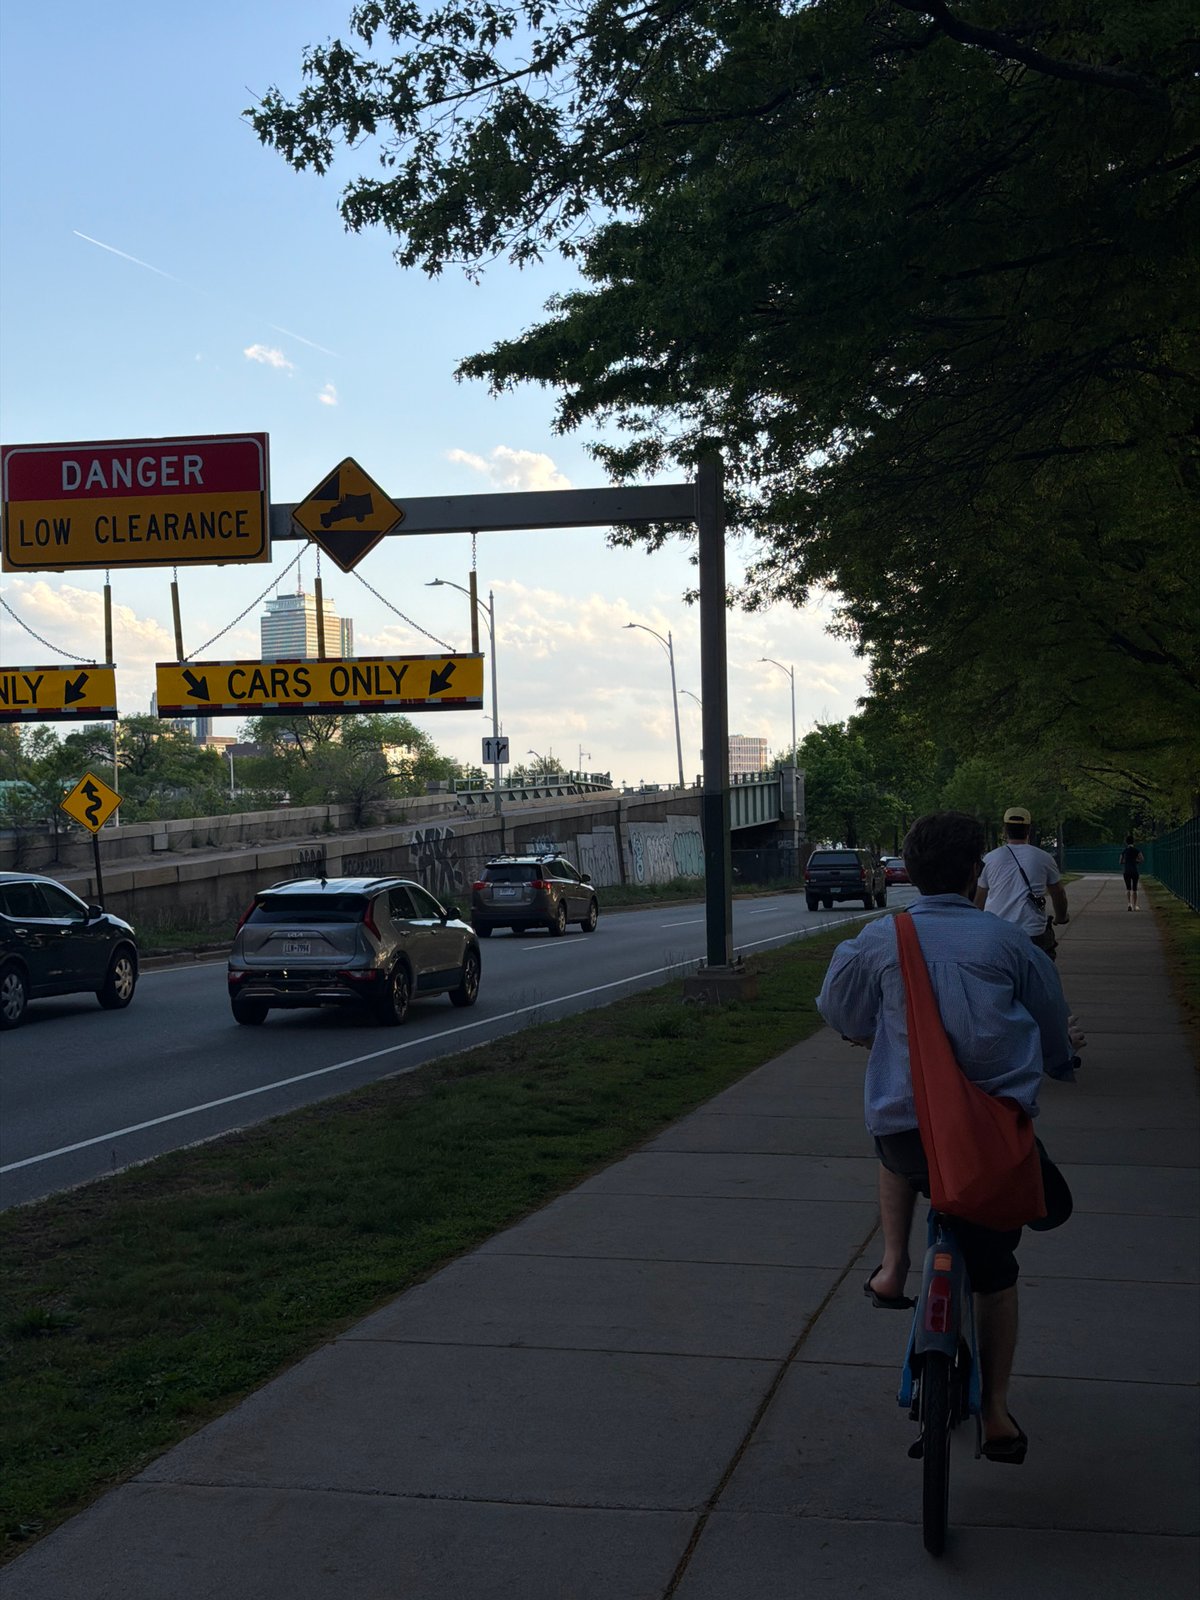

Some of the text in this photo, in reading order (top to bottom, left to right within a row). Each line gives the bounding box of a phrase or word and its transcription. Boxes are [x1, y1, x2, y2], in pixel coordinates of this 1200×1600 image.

[62, 455, 205, 490] DANGER
[19, 509, 250, 548] LOW CLEARANCE
[227, 664, 410, 699] CARS ONLY
